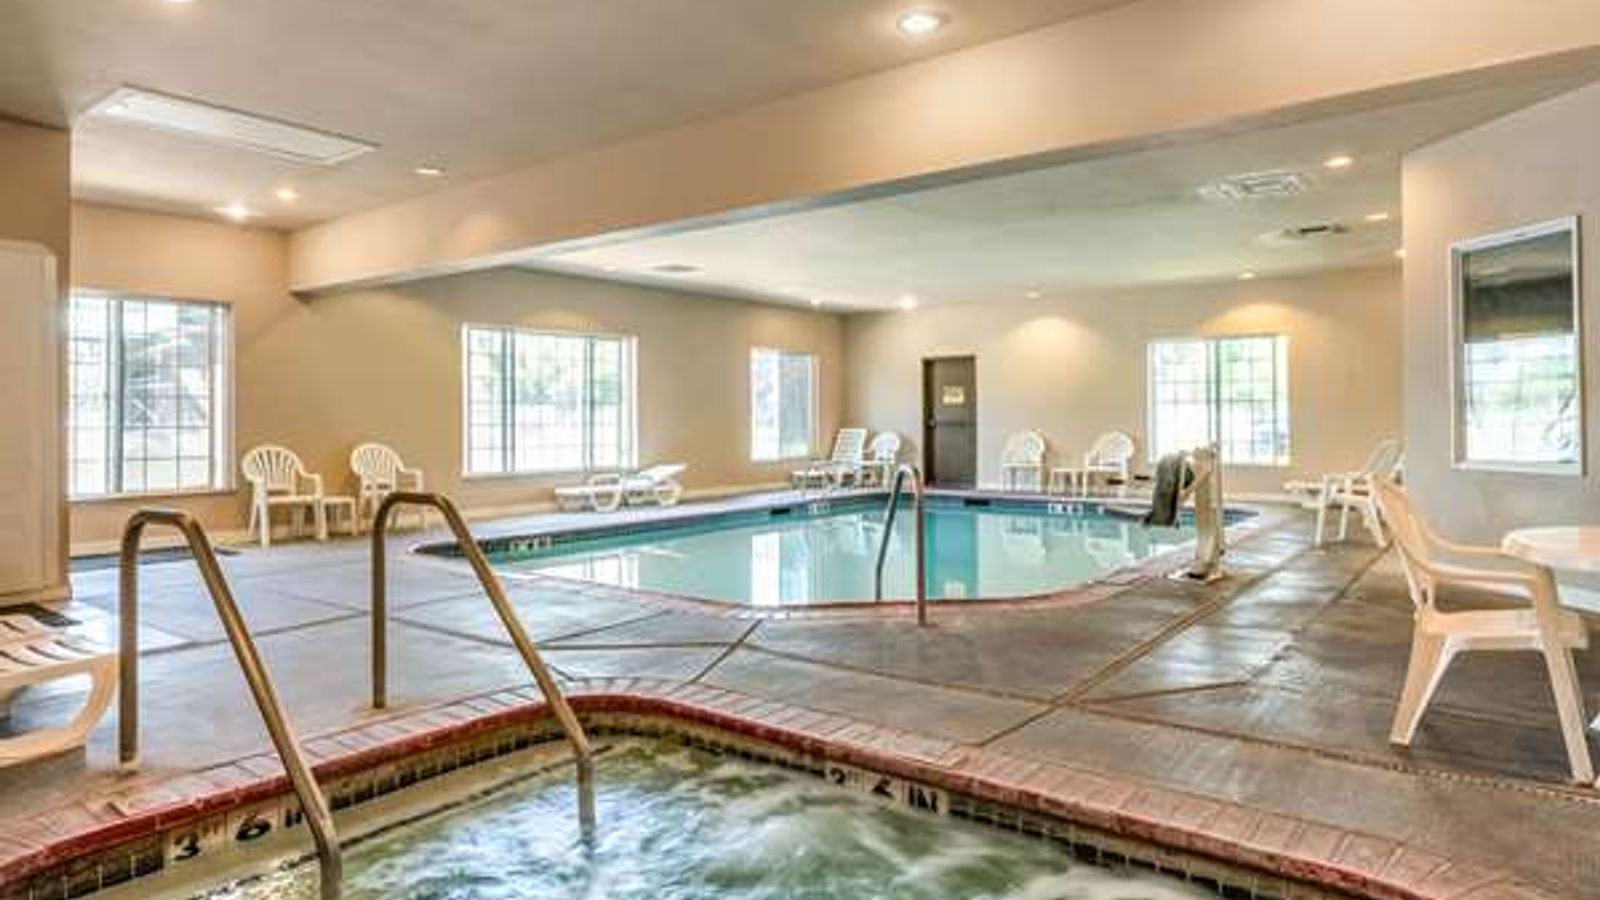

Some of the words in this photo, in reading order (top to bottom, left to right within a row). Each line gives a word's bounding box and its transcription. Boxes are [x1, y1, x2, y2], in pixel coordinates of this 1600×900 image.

[908, 783, 938, 814] IN
[173, 833, 201, 860] 3
[235, 812, 271, 841] 6
